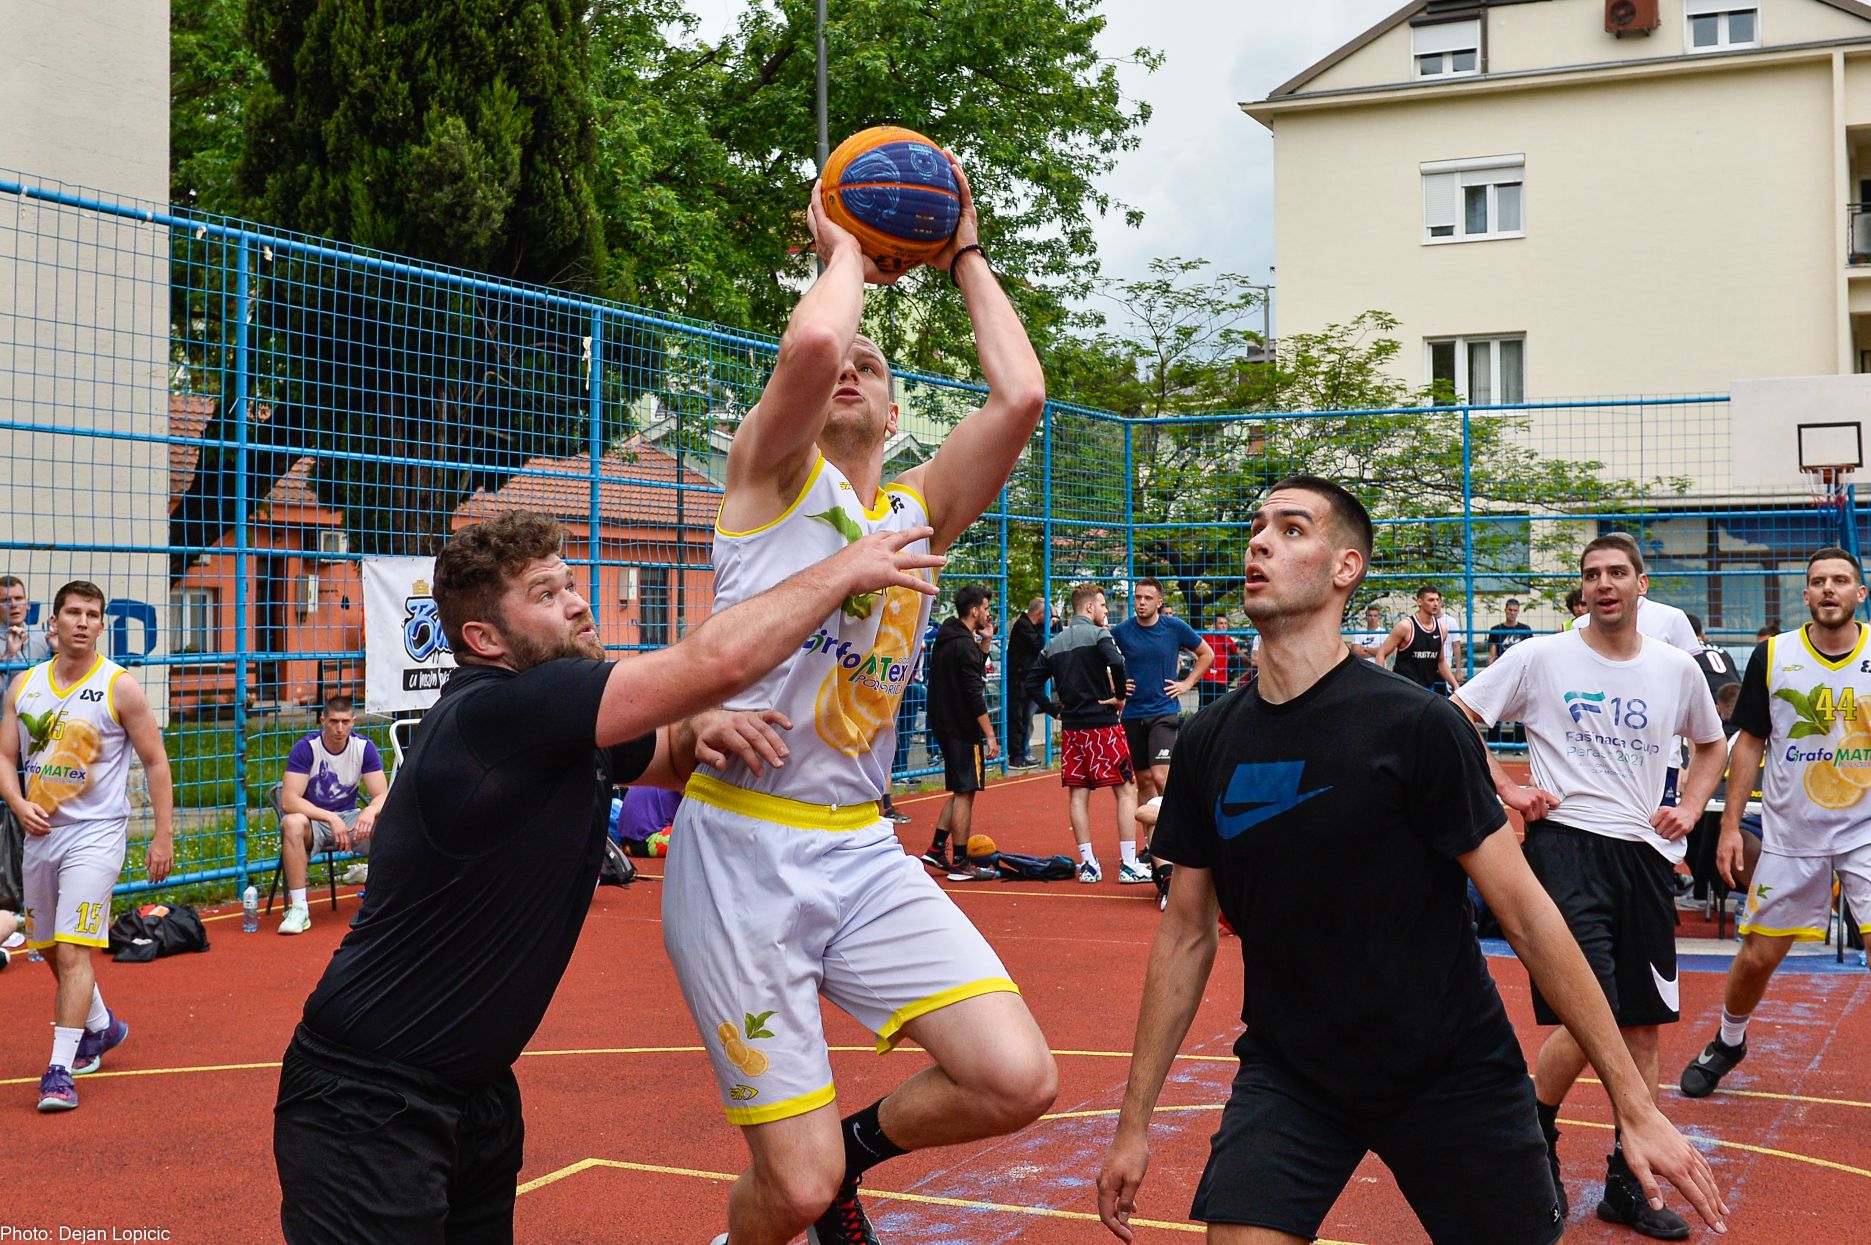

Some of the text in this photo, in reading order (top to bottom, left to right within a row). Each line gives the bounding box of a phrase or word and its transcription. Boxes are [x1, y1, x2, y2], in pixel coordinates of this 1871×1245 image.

[1706, 651, 1727, 673] 0
[1816, 687, 1858, 720] 44
[1565, 730, 1659, 755] Fašna Cup
[1567, 746, 1612, 759] Pera
[1785, 745, 1871, 768] GrafoMAT
[74, 902, 103, 934] 15
